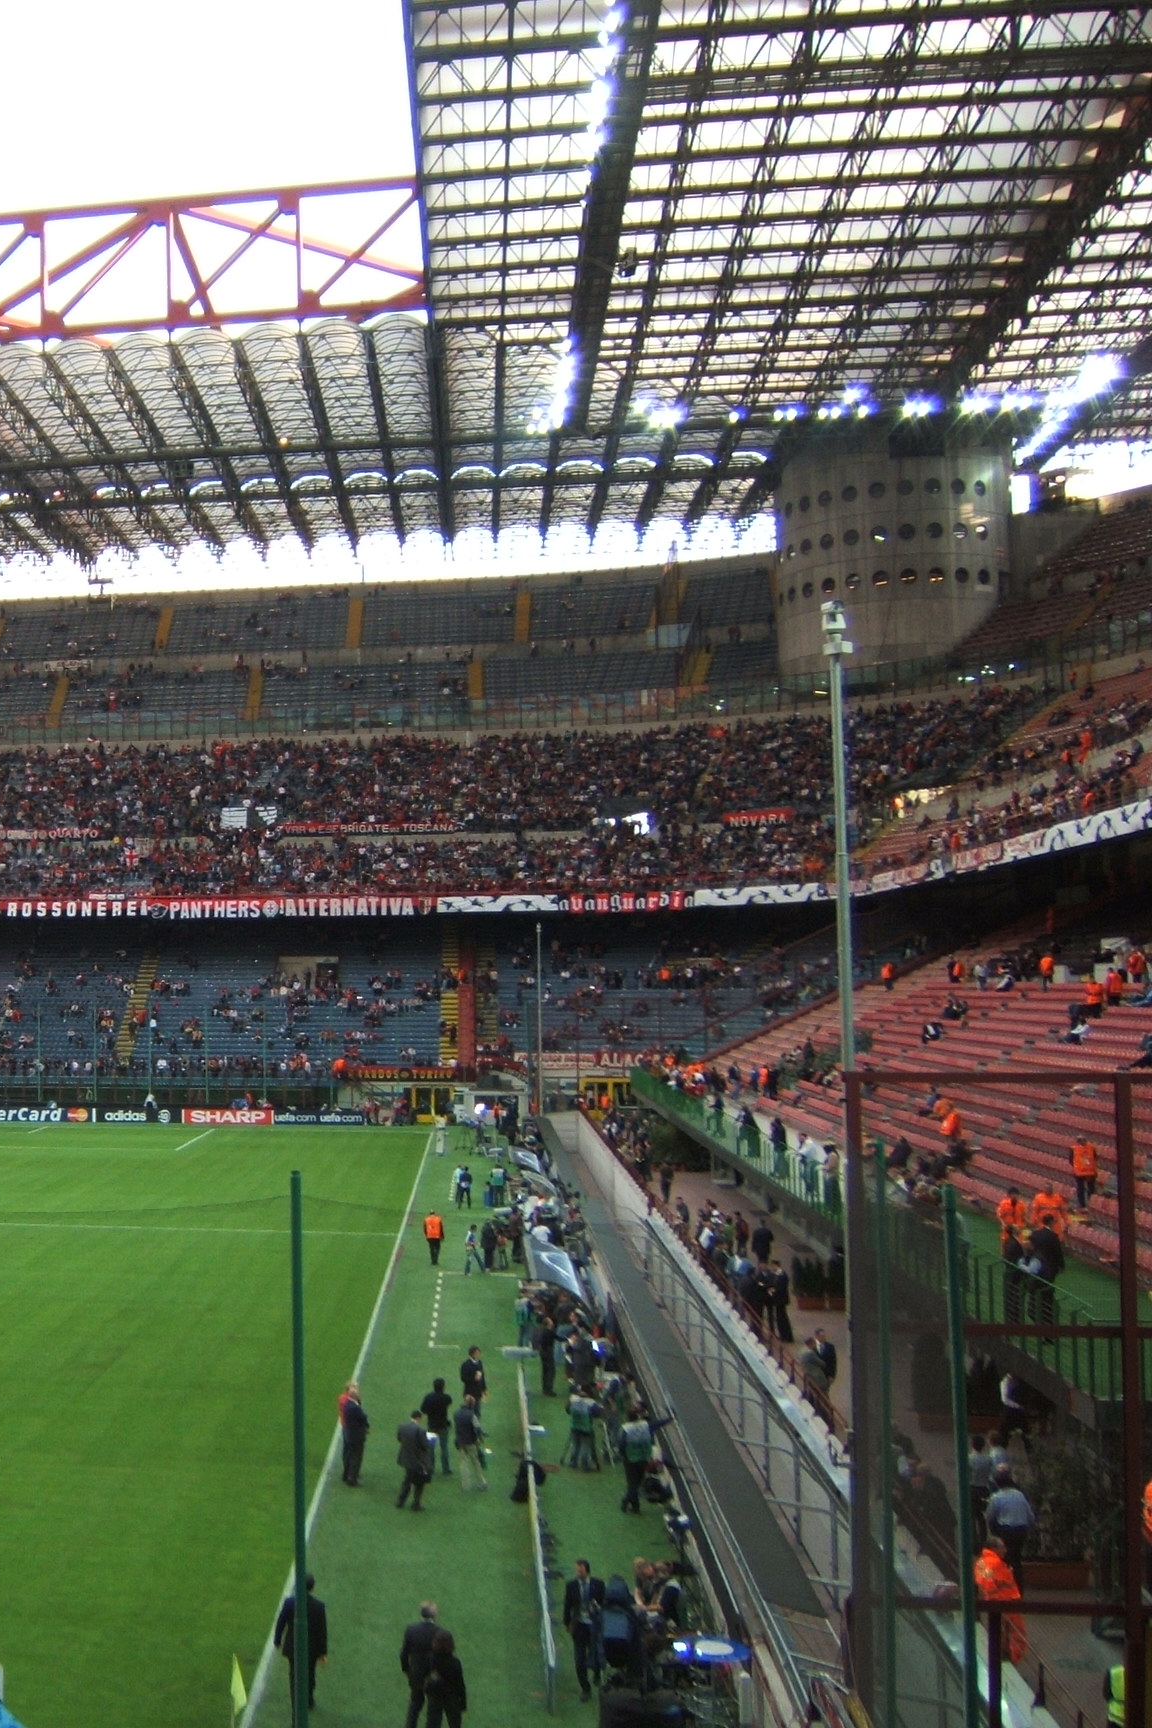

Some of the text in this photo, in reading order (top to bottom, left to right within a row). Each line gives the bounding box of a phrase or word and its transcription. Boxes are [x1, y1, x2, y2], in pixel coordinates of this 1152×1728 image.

[729, 813, 786, 827] NOVARA
[402, 822, 455, 833] TOSCANA
[169, 900, 260, 919] PANTHERS
[285, 898, 415, 917] ALTERNATIVA
[104, 1109, 147, 1122] adidas
[190, 1111, 266, 1123] SHARP
